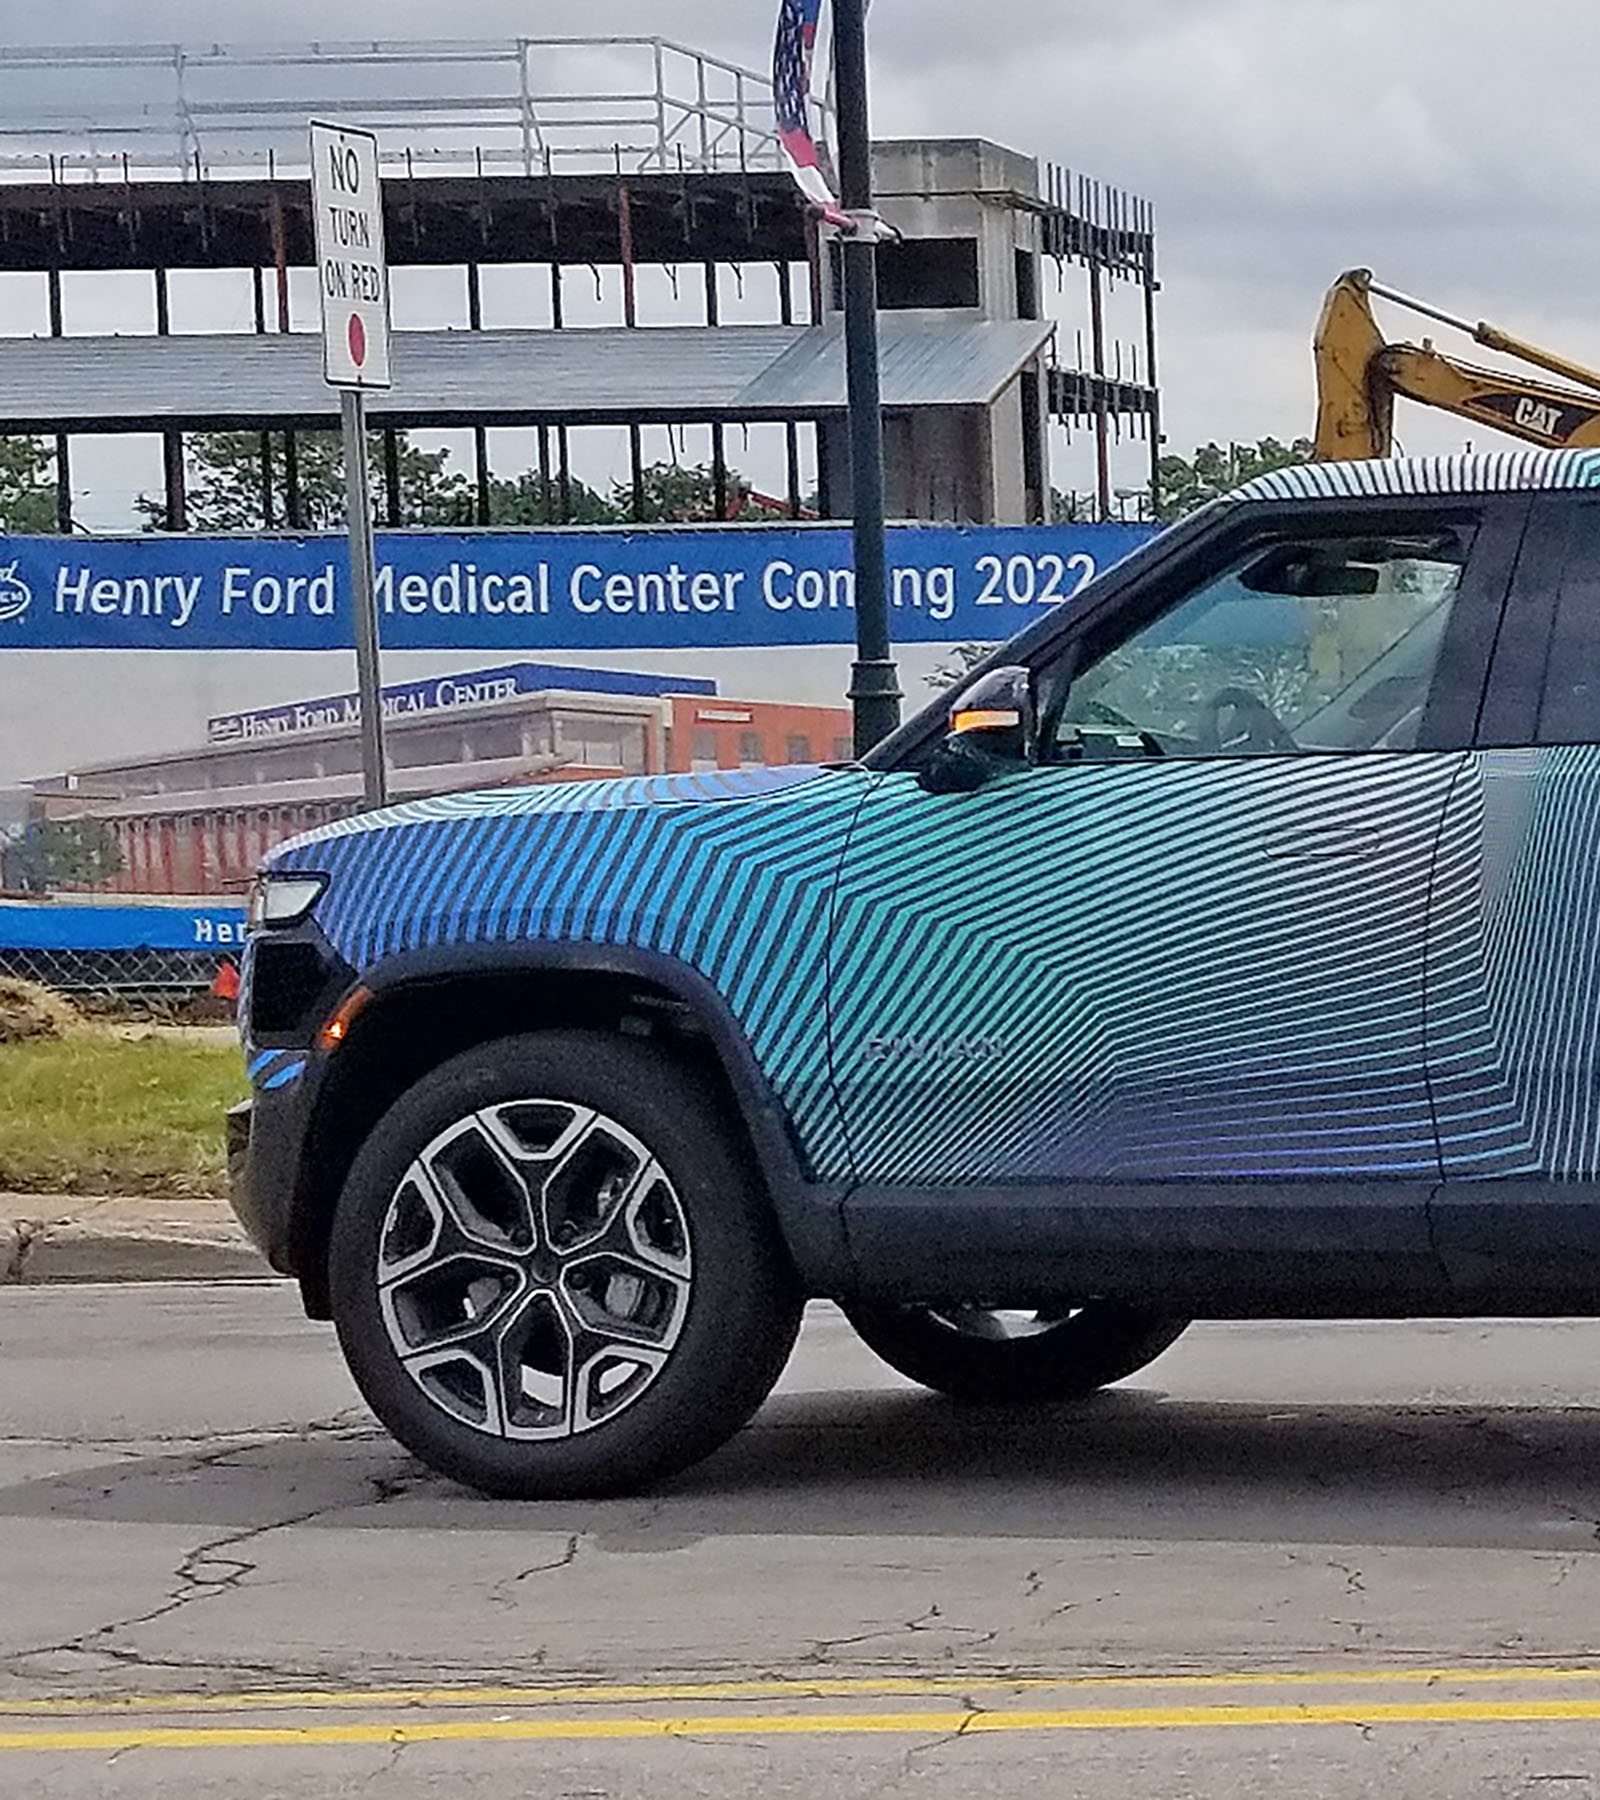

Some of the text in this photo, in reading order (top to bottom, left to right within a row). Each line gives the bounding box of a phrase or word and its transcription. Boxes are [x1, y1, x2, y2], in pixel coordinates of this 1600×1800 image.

[328, 144, 360, 194] NO
[327, 206, 370, 249] TURN
[324, 259, 381, 303] ON RED
[1515, 397, 1564, 435] CAT
[54, 565, 203, 628] Henry
[221, 563, 336, 616] Ford
[569, 562, 744, 614] Center
[763, 560, 954, 620] Comng
[975, 553, 1096, 606] 2022
[344, 690, 427, 724] MICAL
[435, 677, 521, 708] CENTER
